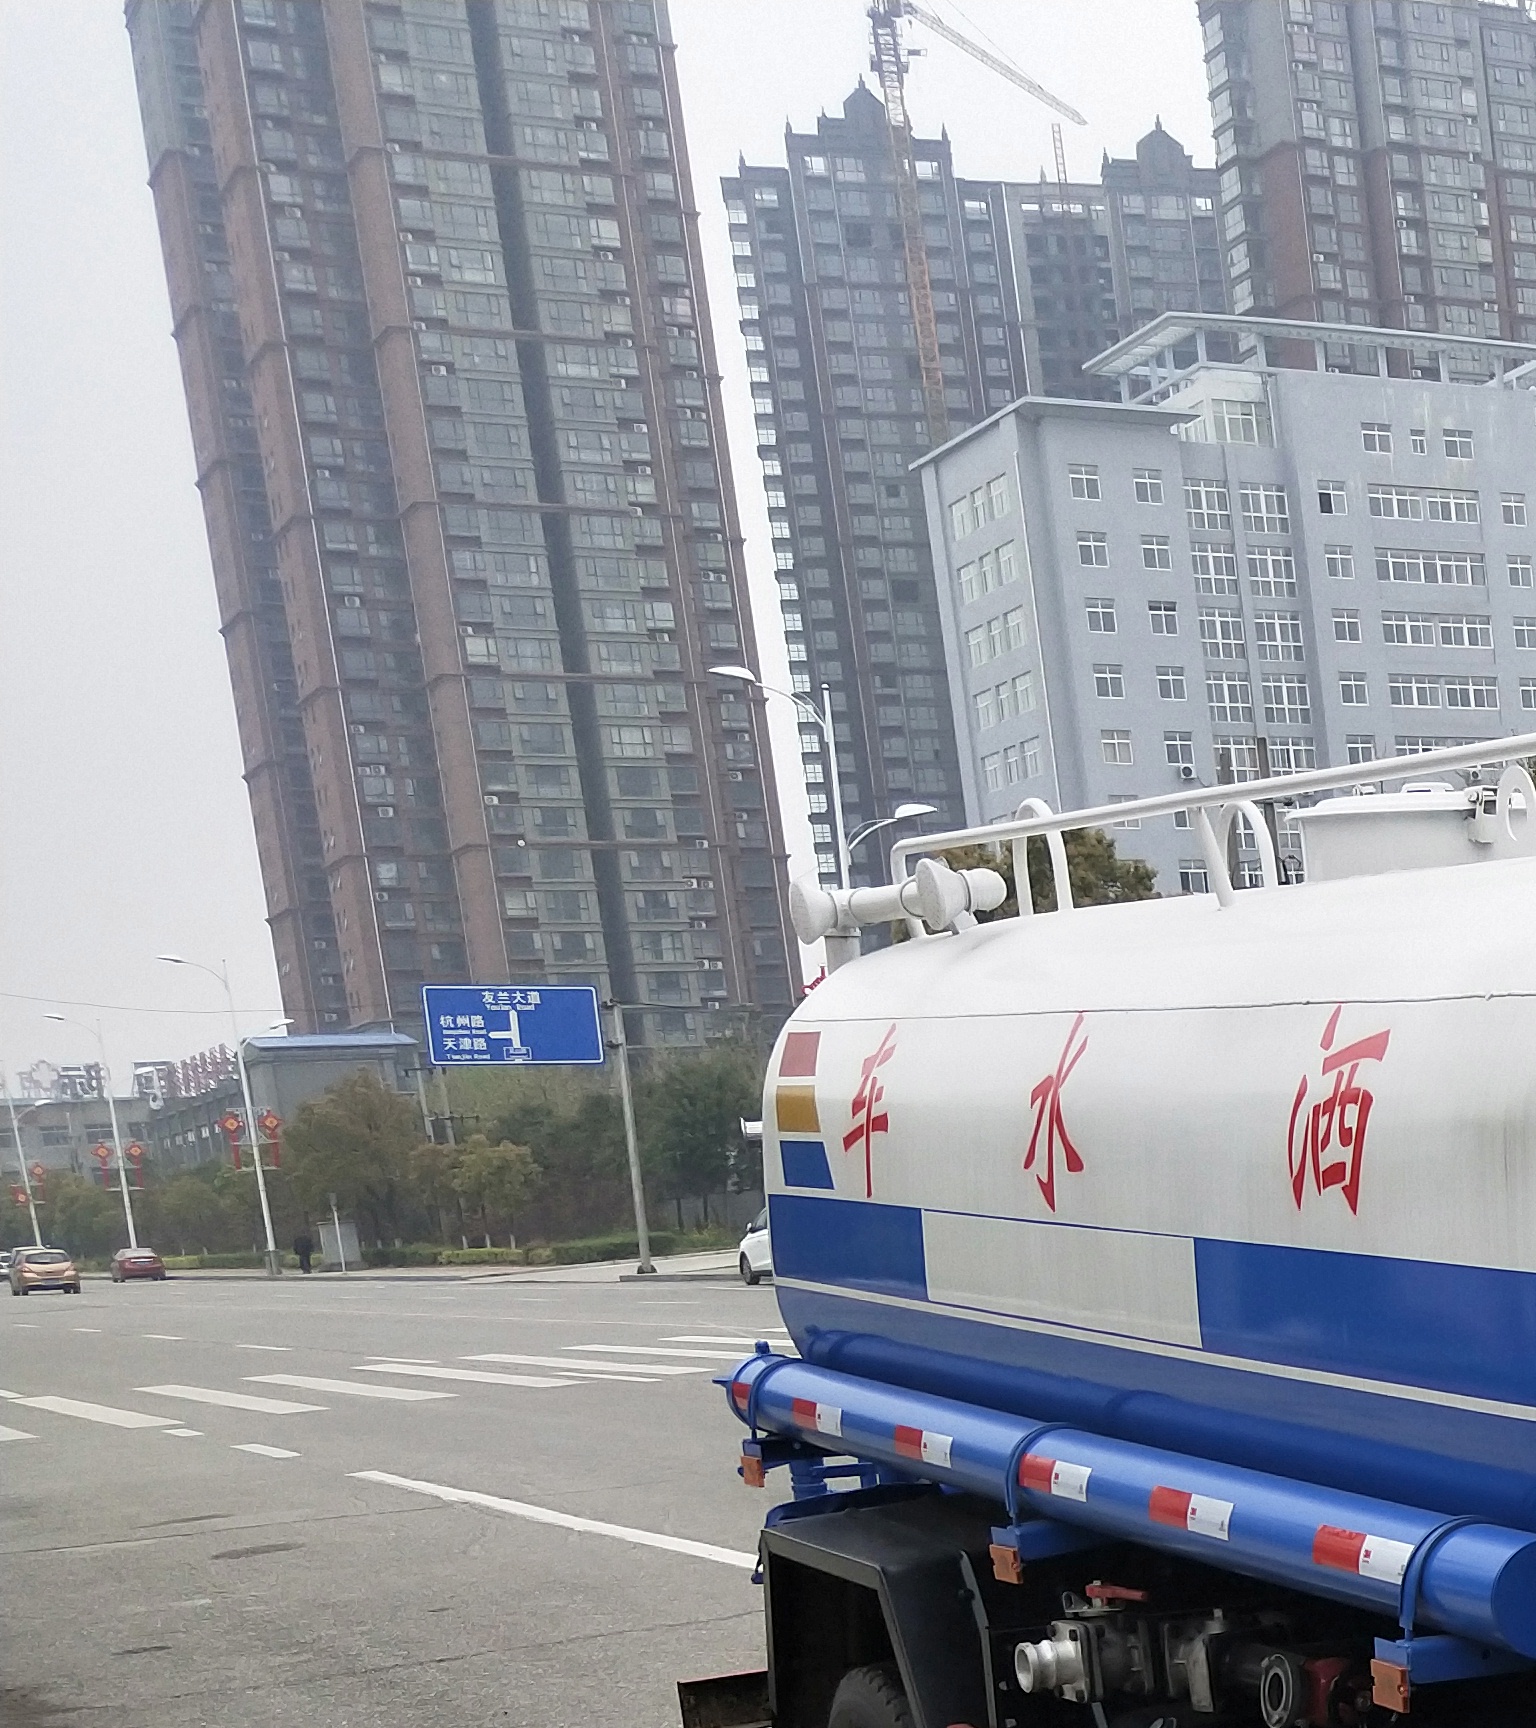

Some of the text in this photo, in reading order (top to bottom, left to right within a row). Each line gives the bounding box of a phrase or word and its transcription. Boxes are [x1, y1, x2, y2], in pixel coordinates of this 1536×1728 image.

[481, 991, 541, 1004] 友兰大道
[439, 1015, 485, 1028] 杭州路
[442, 1037, 488, 1051] 天津路
